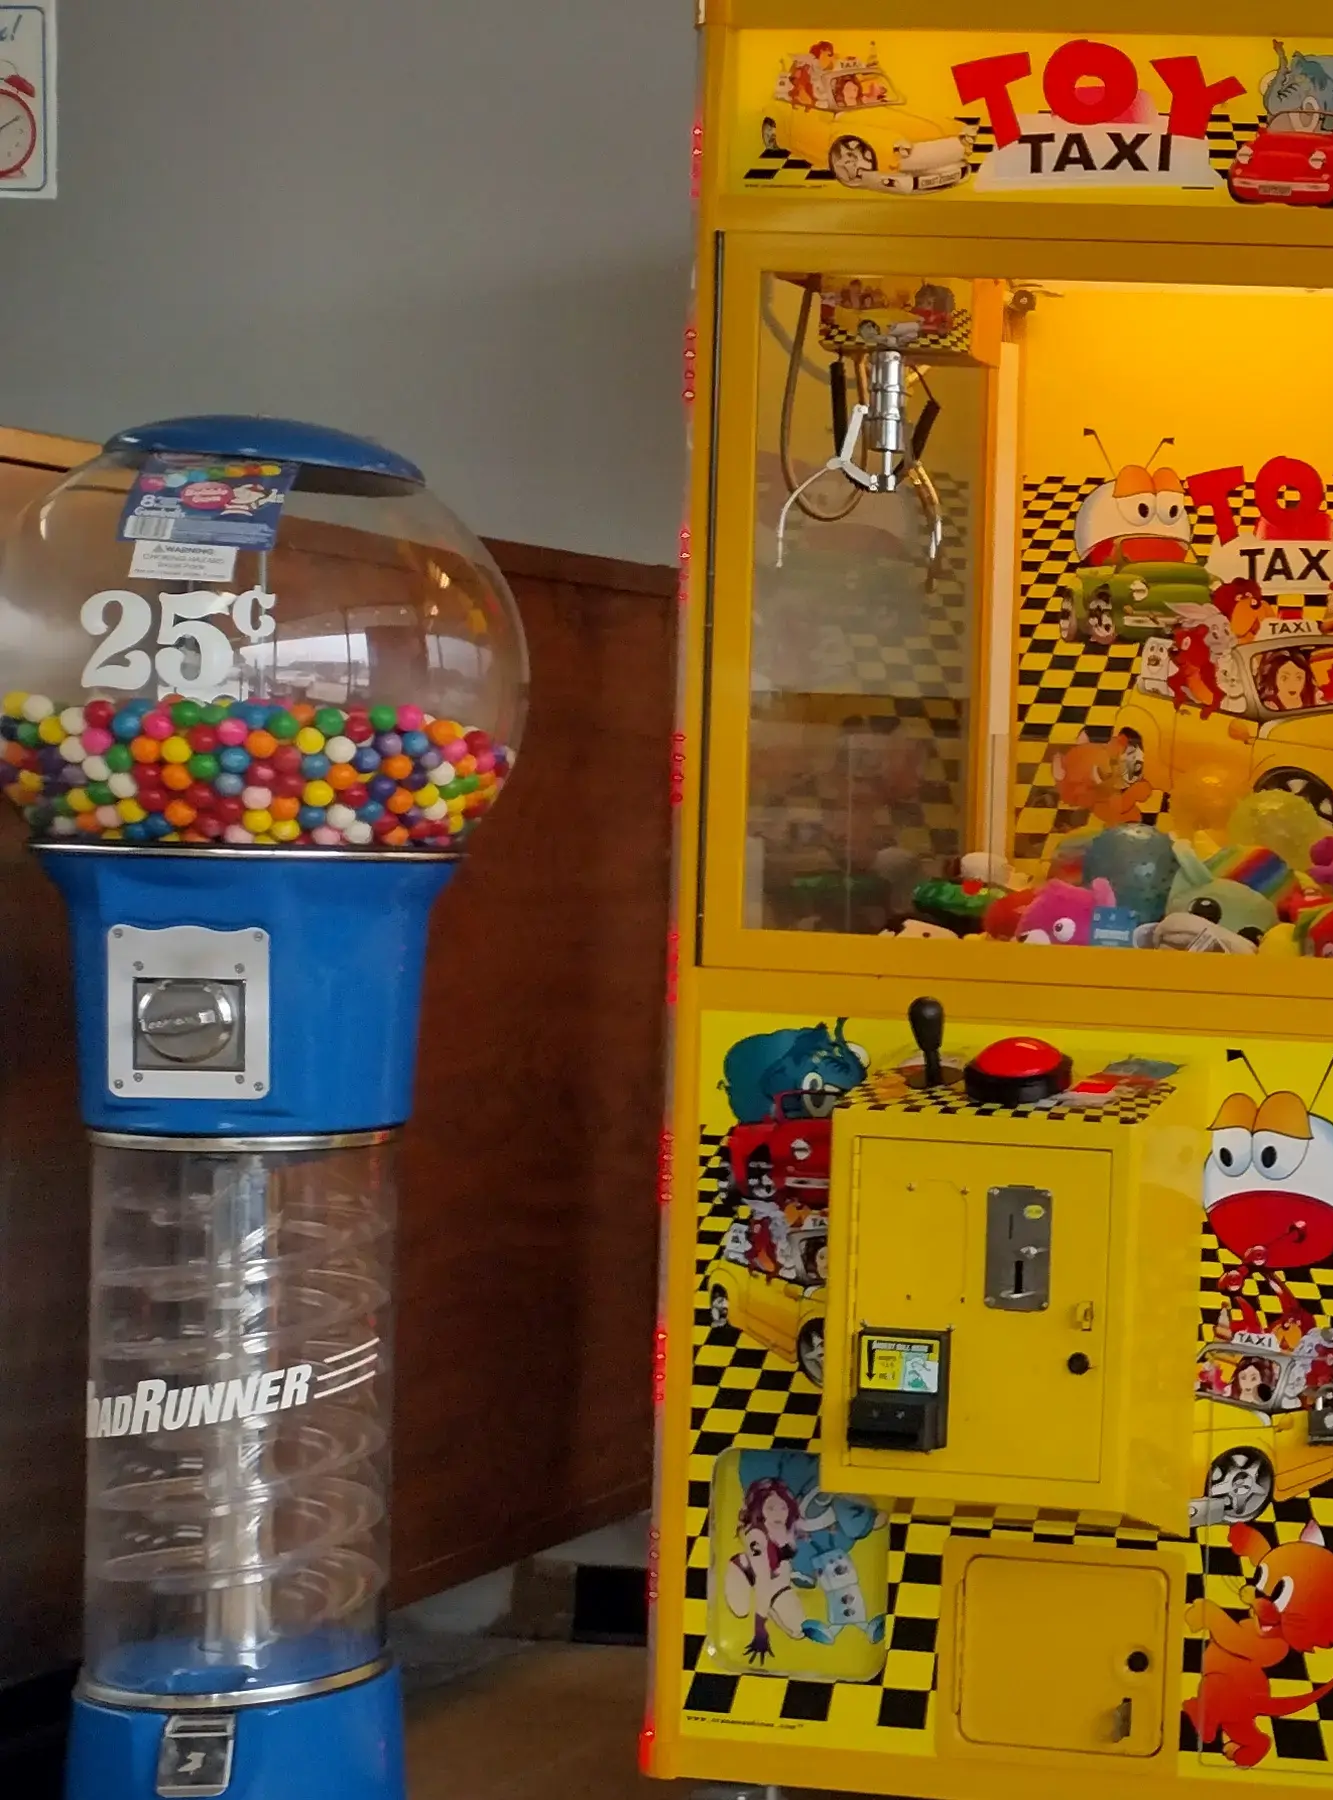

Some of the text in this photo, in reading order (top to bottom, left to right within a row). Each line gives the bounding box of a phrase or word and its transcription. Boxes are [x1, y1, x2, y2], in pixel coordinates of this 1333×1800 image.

[951, 39, 1248, 151] TOY
[1018, 132, 1172, 174] TAXI
[81, 585, 276, 690] 25¢
[1268, 621, 1313, 635] TAXI
[1237, 1332, 1273, 1348] TAXI
